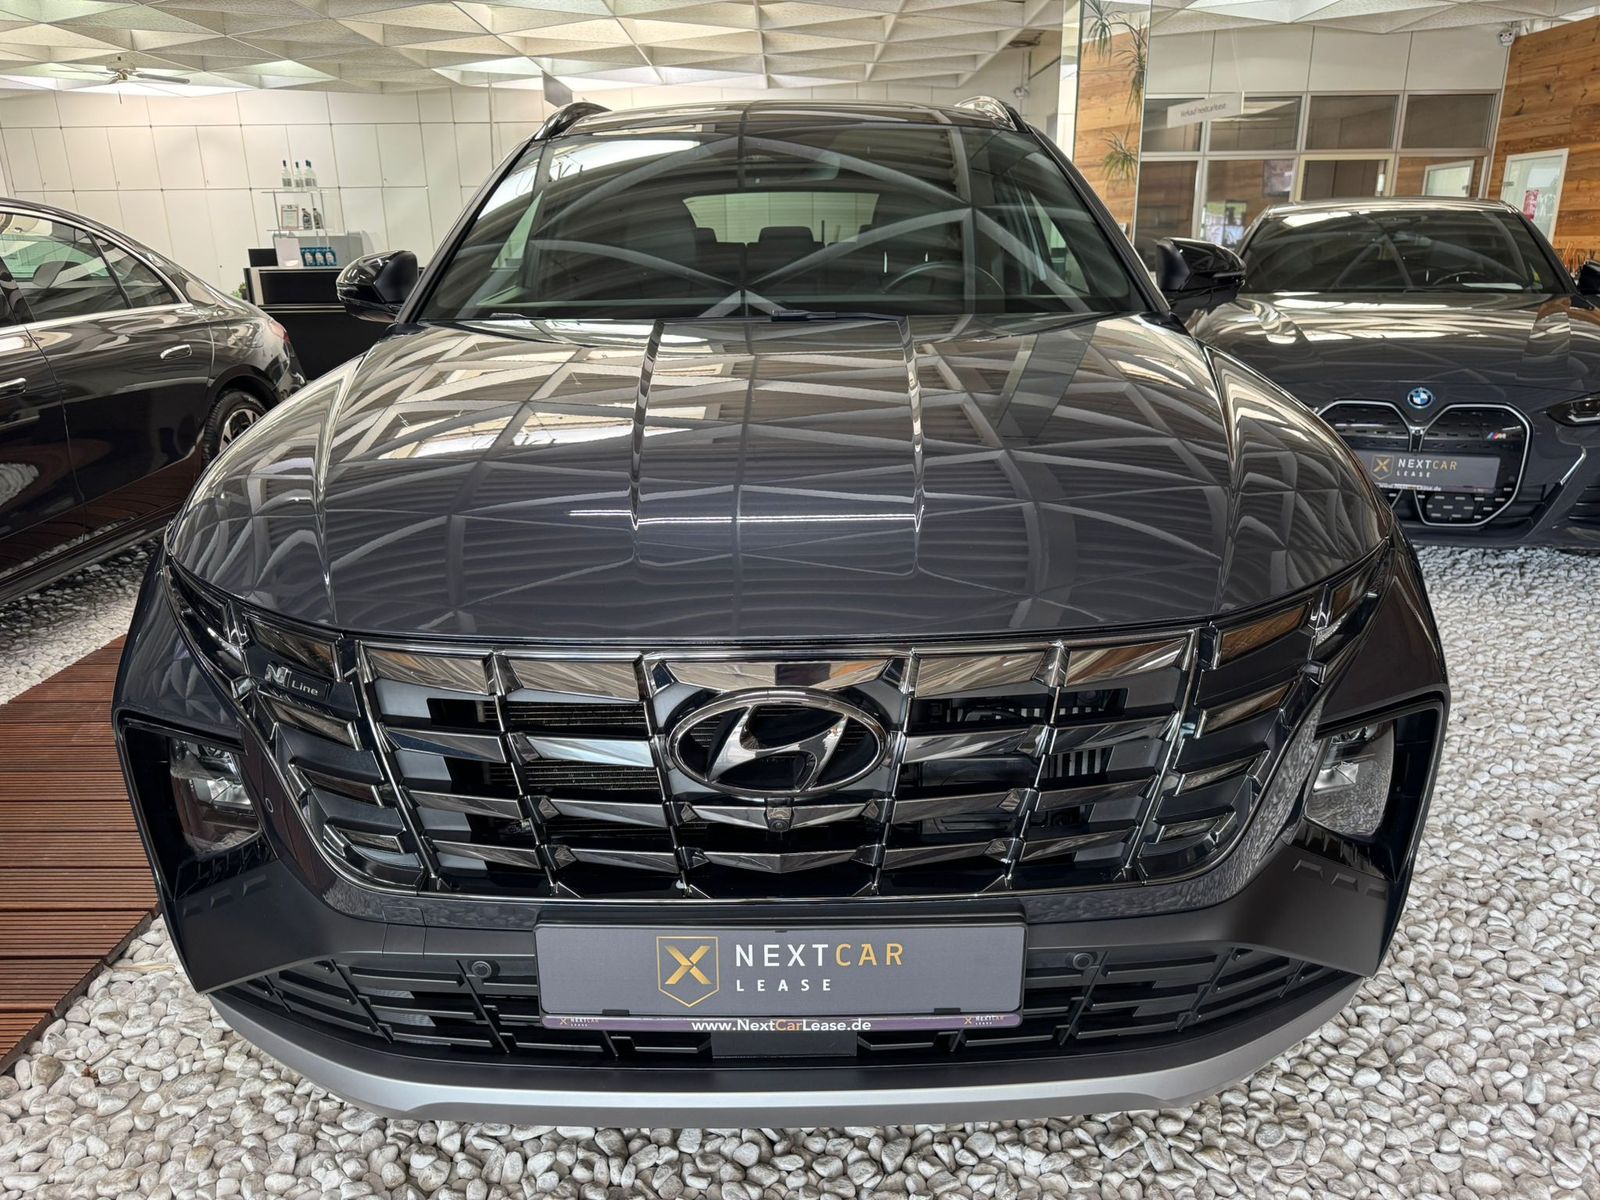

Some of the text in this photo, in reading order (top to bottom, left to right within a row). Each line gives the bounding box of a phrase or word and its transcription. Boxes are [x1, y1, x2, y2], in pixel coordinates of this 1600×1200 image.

[1398, 458, 1457, 470] NEXTCAR
[264, 663, 319, 696] N Line
[735, 943, 903, 967] NEXTCAR
[736, 979, 831, 992] LEASE
[691, 1018, 872, 1031] www.NextCarLease.de
